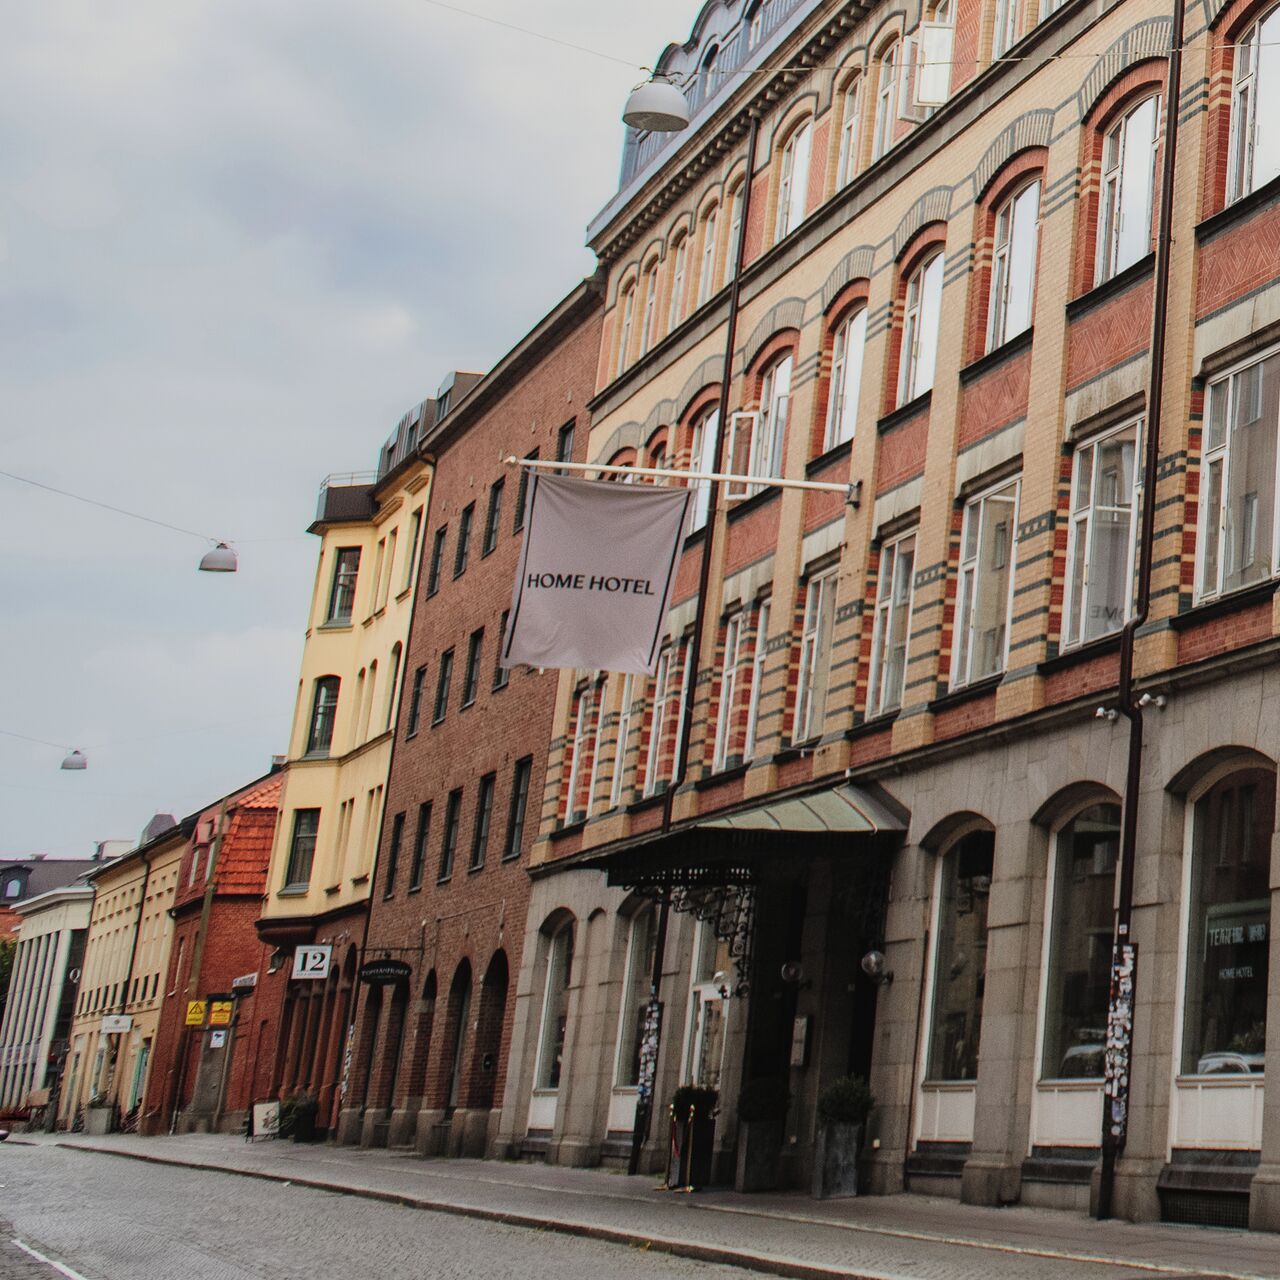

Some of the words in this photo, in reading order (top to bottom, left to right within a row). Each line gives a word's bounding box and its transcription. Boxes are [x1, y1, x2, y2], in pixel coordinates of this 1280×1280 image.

[527, 573, 586, 589] HOME
[588, 575, 655, 596] HOTEL
[299, 951, 326, 972] 12
